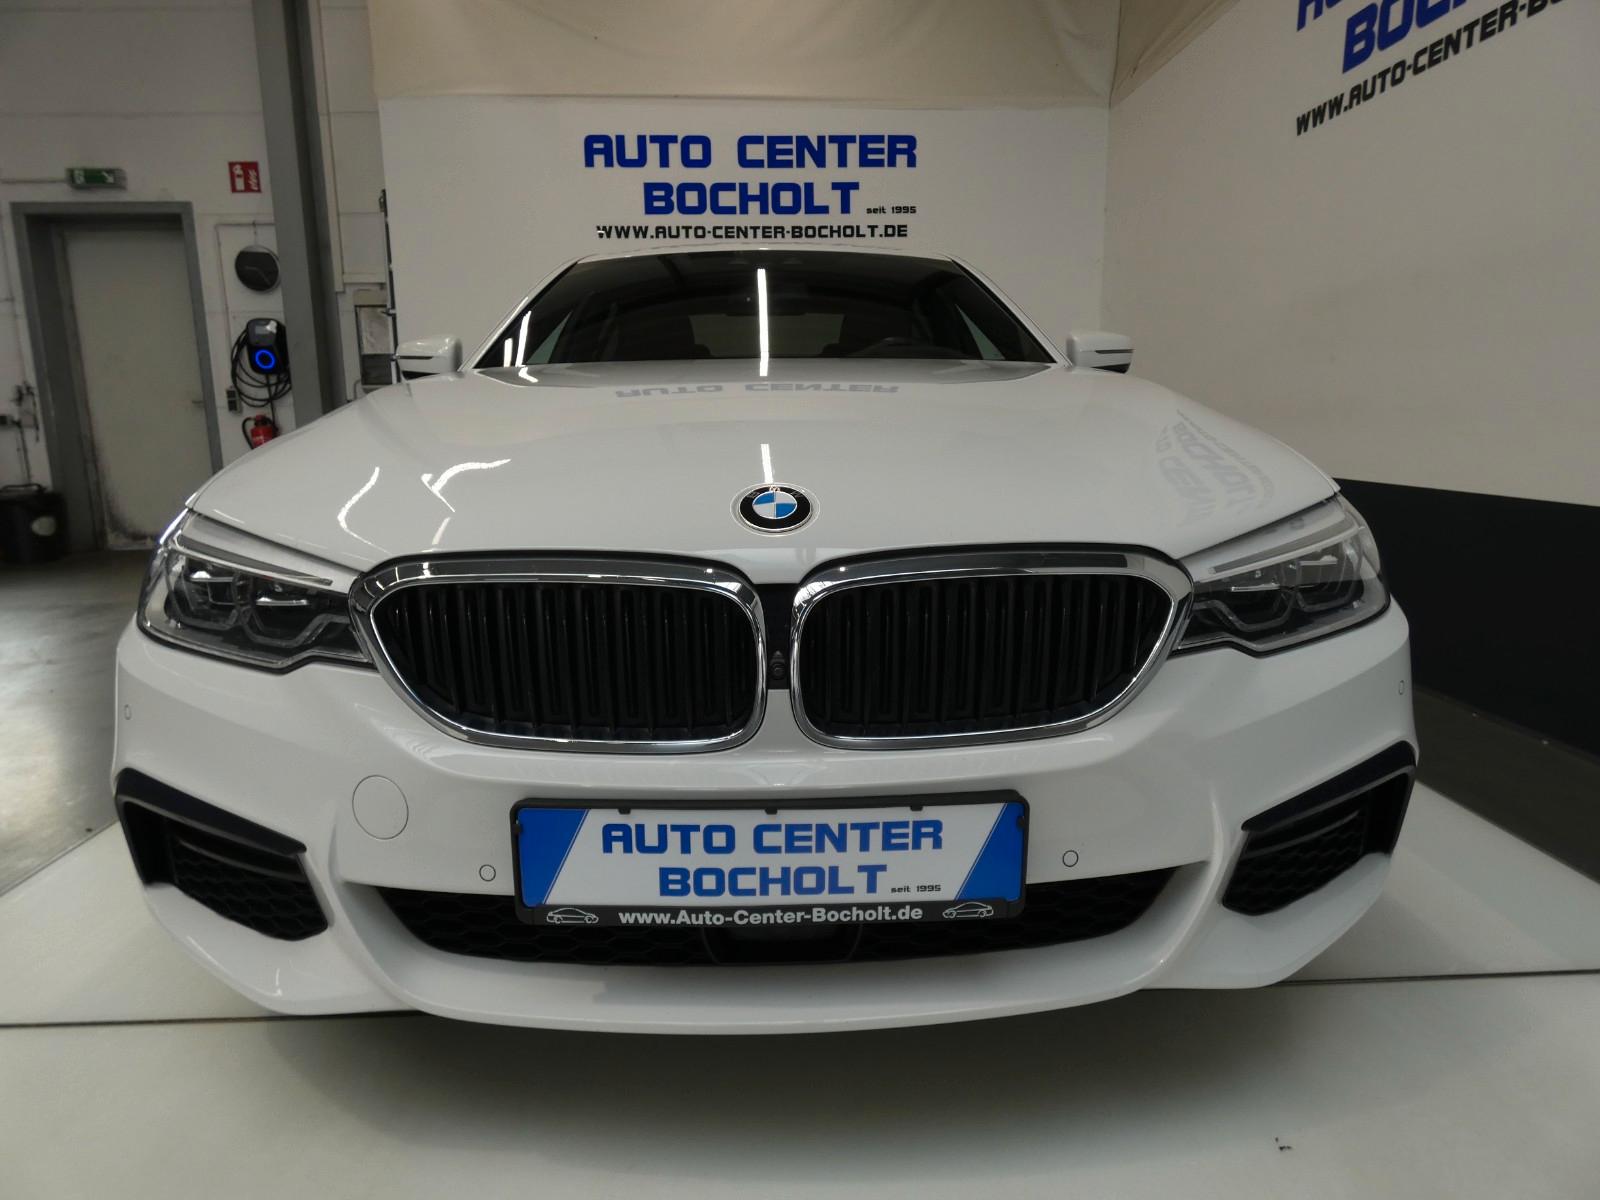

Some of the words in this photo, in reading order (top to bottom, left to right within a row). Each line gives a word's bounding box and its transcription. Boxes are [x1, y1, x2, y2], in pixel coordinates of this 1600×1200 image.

[1342, 0, 1467, 73] BO
[1296, 0, 1563, 136] WWW.AUTO-CENTER-B
[584, 134, 712, 168] AUTO
[737, 134, 917, 168] CENTER
[643, 181, 860, 215] BOCHOLT
[866, 205, 887, 215] seit
[891, 205, 917, 215] 1995
[596, 224, 908, 239] WWW.AUTO-CENTER-BOCHOLT.DE
[602, 823, 736, 855] AUTO
[753, 819, 943, 855] CENTER
[658, 864, 887, 897] BOCHOLT
[891, 885, 911, 894] seit
[916, 884, 942, 893] 1995
[618, 905, 923, 926] www.Auto-Center-Bocholt.de
